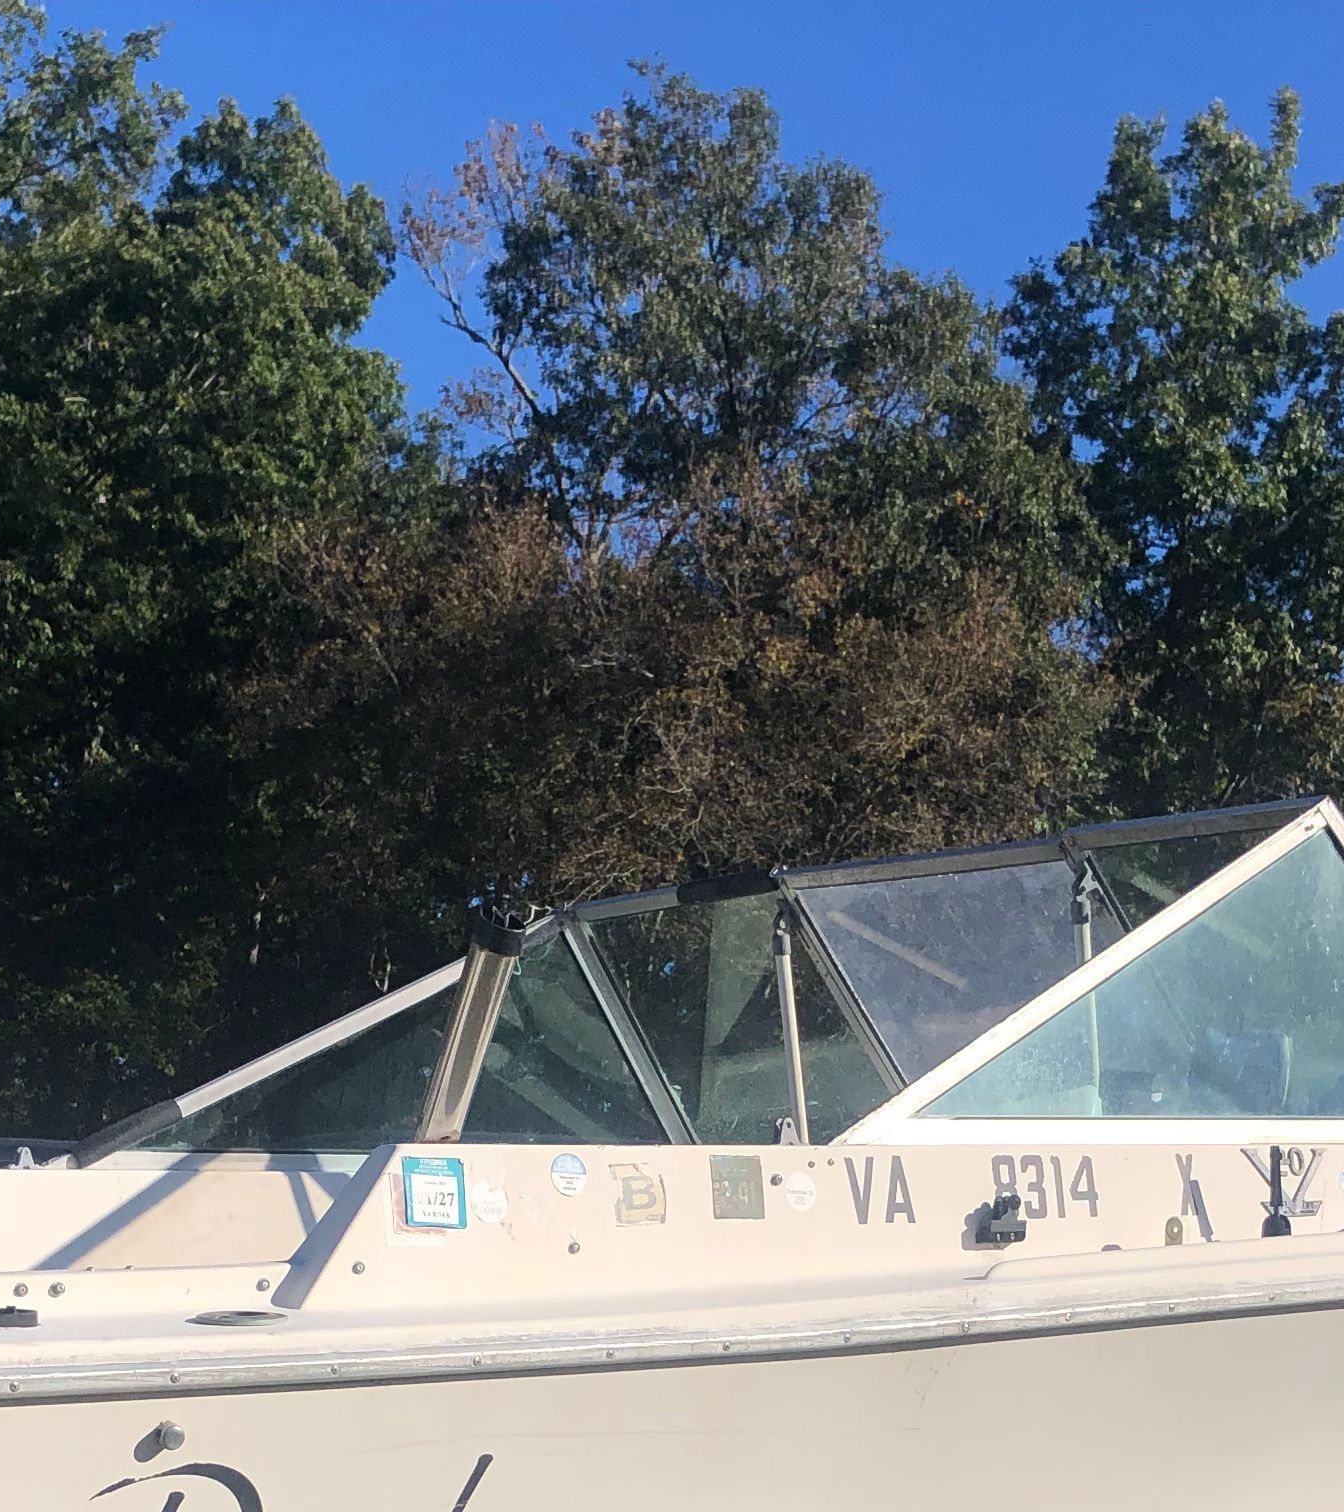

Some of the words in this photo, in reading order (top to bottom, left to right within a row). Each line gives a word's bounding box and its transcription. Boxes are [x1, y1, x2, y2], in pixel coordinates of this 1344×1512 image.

[843, 1155, 917, 1225] VA
[991, 1154, 1099, 1219] 8314
[1174, 1153, 1200, 1216] X
